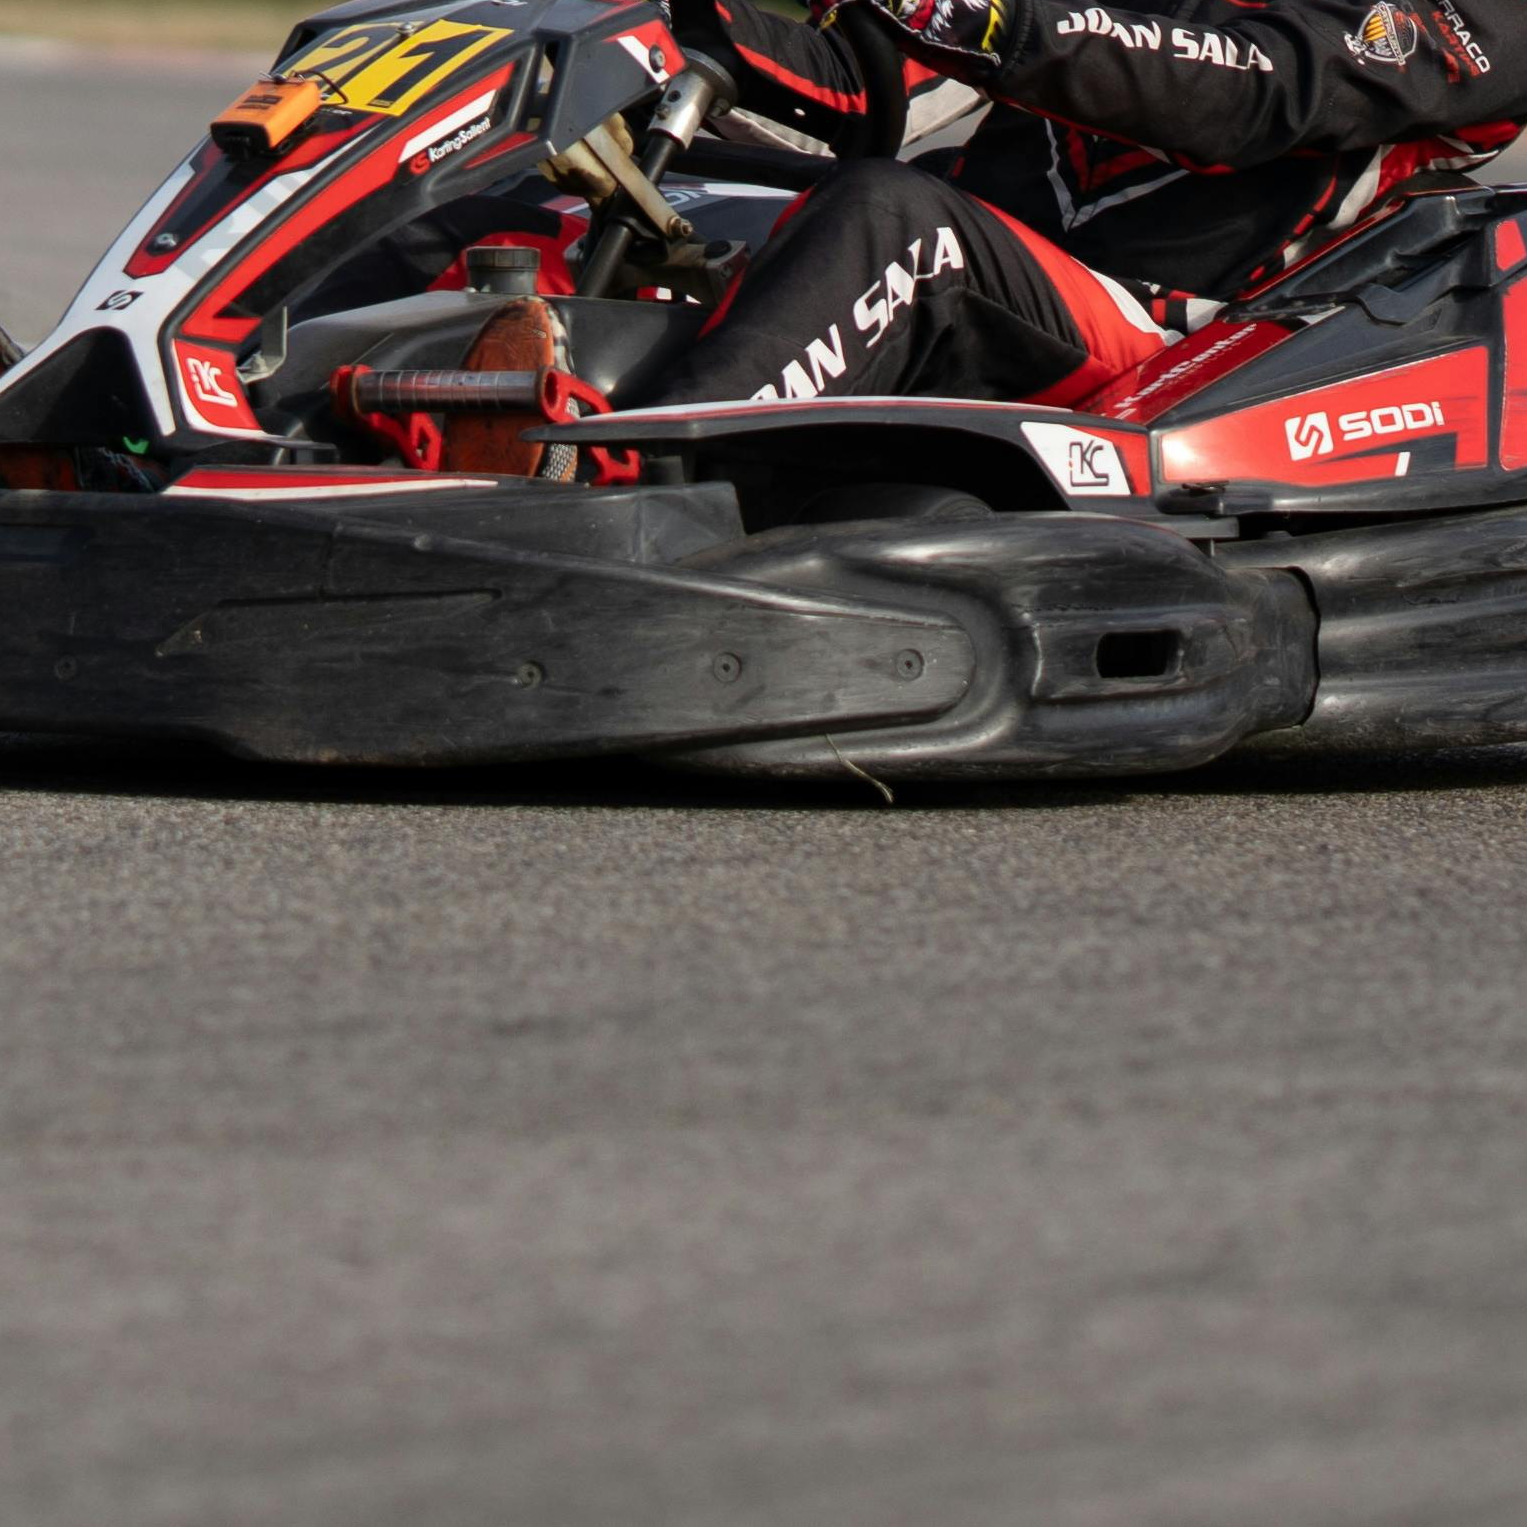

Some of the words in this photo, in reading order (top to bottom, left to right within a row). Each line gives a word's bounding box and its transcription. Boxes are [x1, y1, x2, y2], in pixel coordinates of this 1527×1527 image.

[1057, 8, 1162, 50] JOAN
[1172, 28, 1273, 72] SALA
[853, 227, 964, 348] SALA
